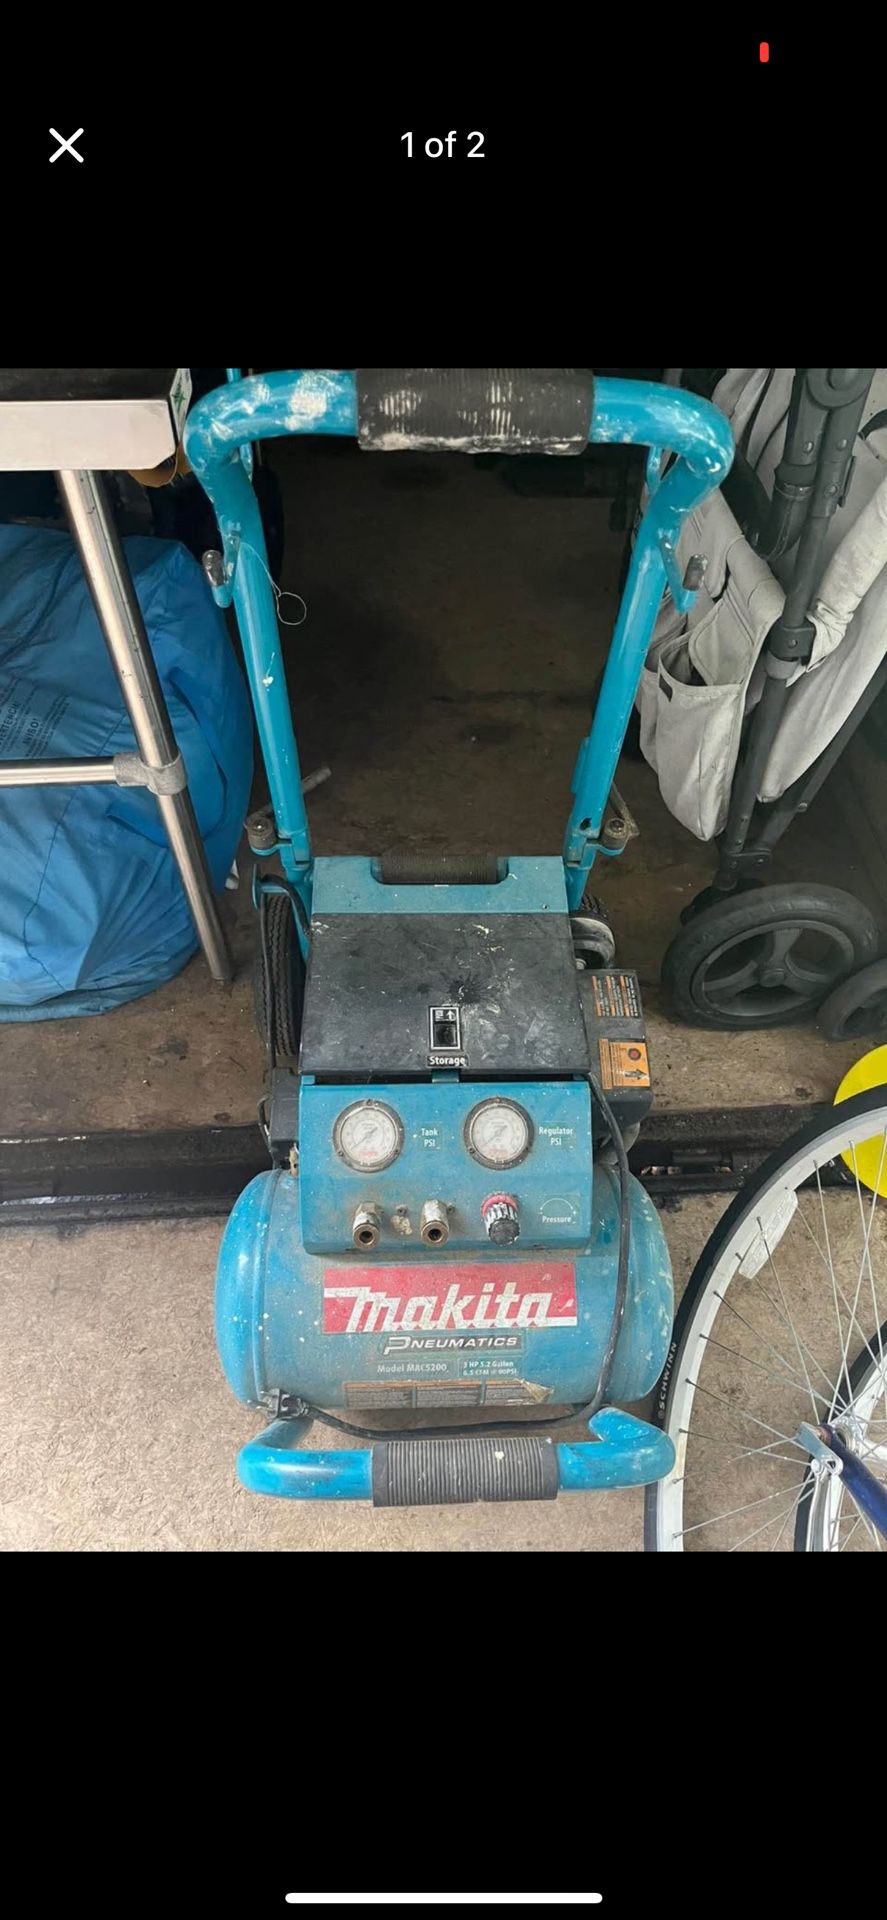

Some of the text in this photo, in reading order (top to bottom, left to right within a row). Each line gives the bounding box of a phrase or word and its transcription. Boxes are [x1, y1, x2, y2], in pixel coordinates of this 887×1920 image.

[429, 1055, 466, 1067] Storage
[421, 1127, 438, 1136] Tank
[539, 1126, 573, 1137] Regulator
[424, 1138, 436, 1148] PSI
[550, 1137, 562, 1146] PSI
[542, 1215, 572, 1224] Pressure
[384, 1335, 517, 1356] PNEUMATICS
[377, 1362, 447, 1373] Model MAC5200
[659, 1342, 677, 1410] SCHWINN
